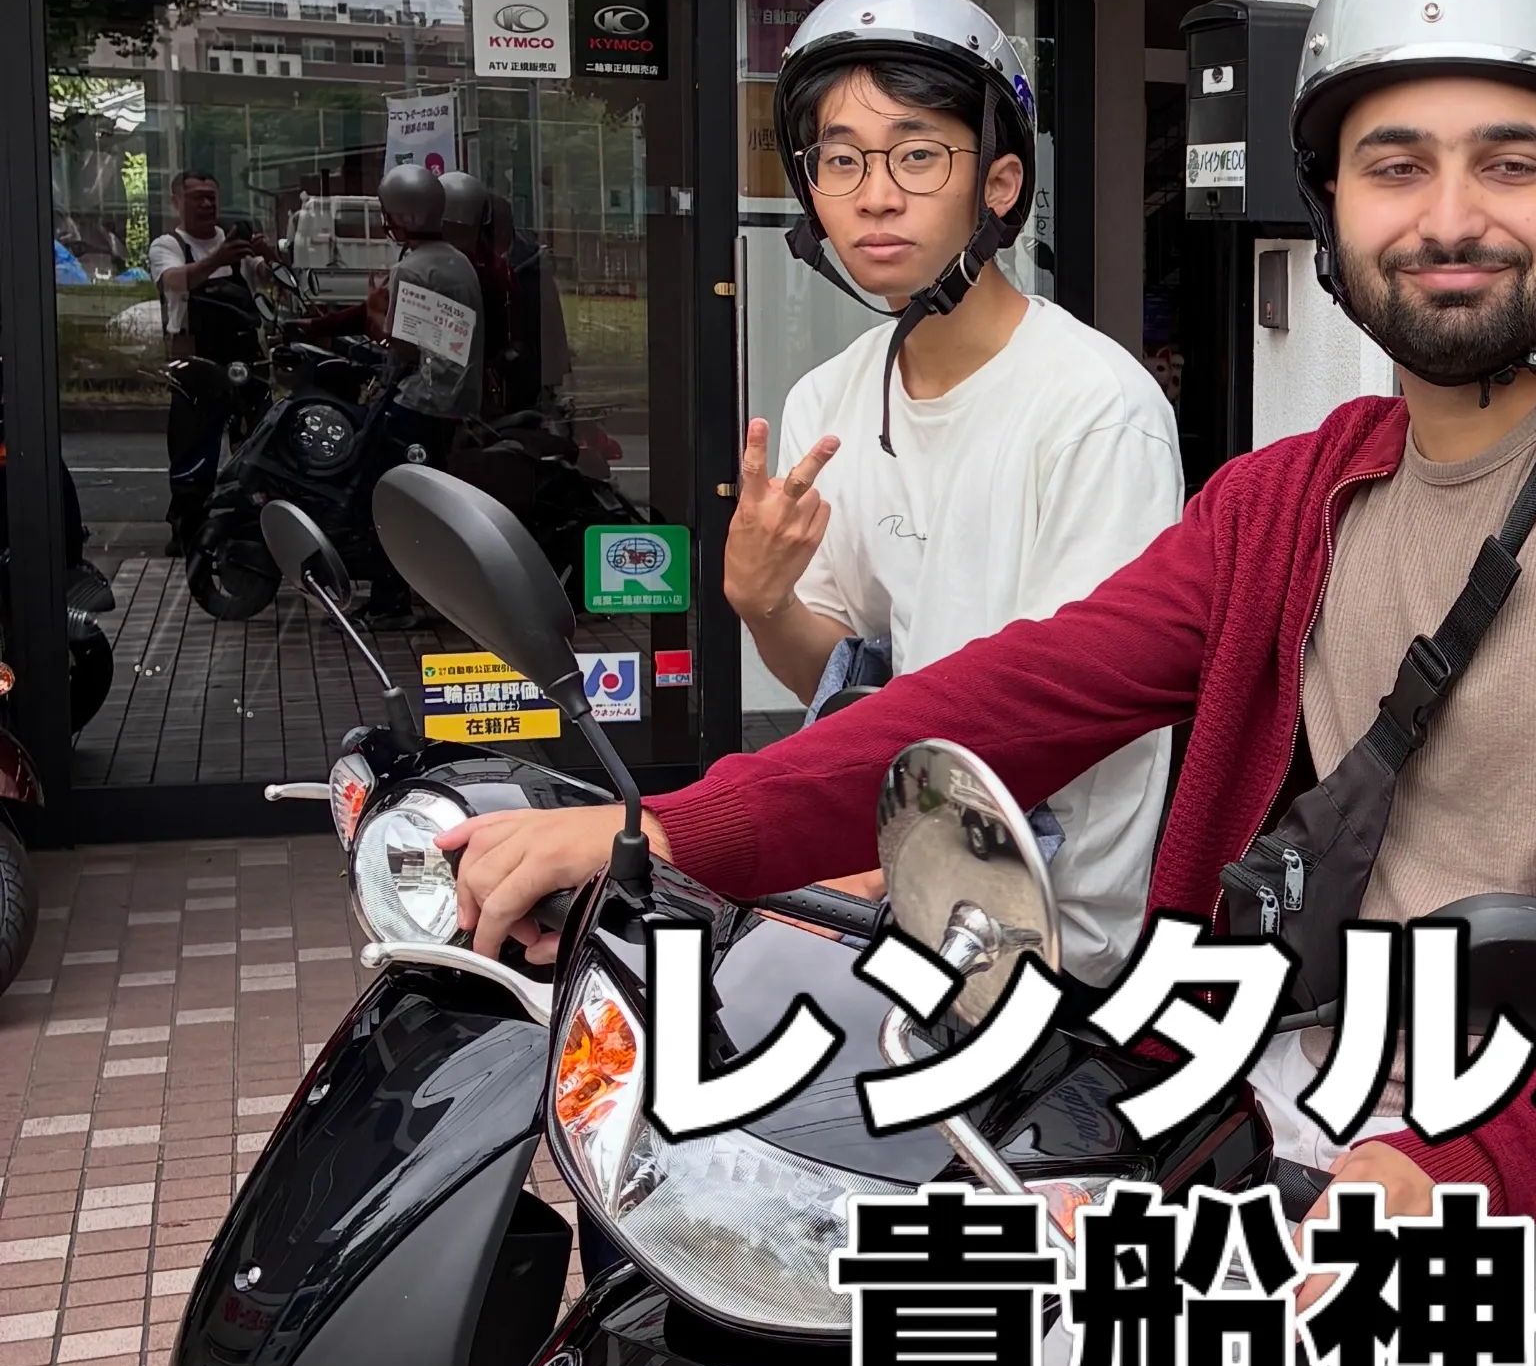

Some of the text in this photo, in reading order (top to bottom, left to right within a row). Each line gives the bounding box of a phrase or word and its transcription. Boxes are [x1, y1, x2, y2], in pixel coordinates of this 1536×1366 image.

[489, 36, 554, 50] KYMCO
[589, 38, 654, 52] KYMCO
[488, 61, 557, 73] ATV 正規販売店
[586, 63, 659, 76] 二輪車正規販売店
[592, 707, 637, 718] クネットAJ
[465, 716, 521, 736] 在籍店
